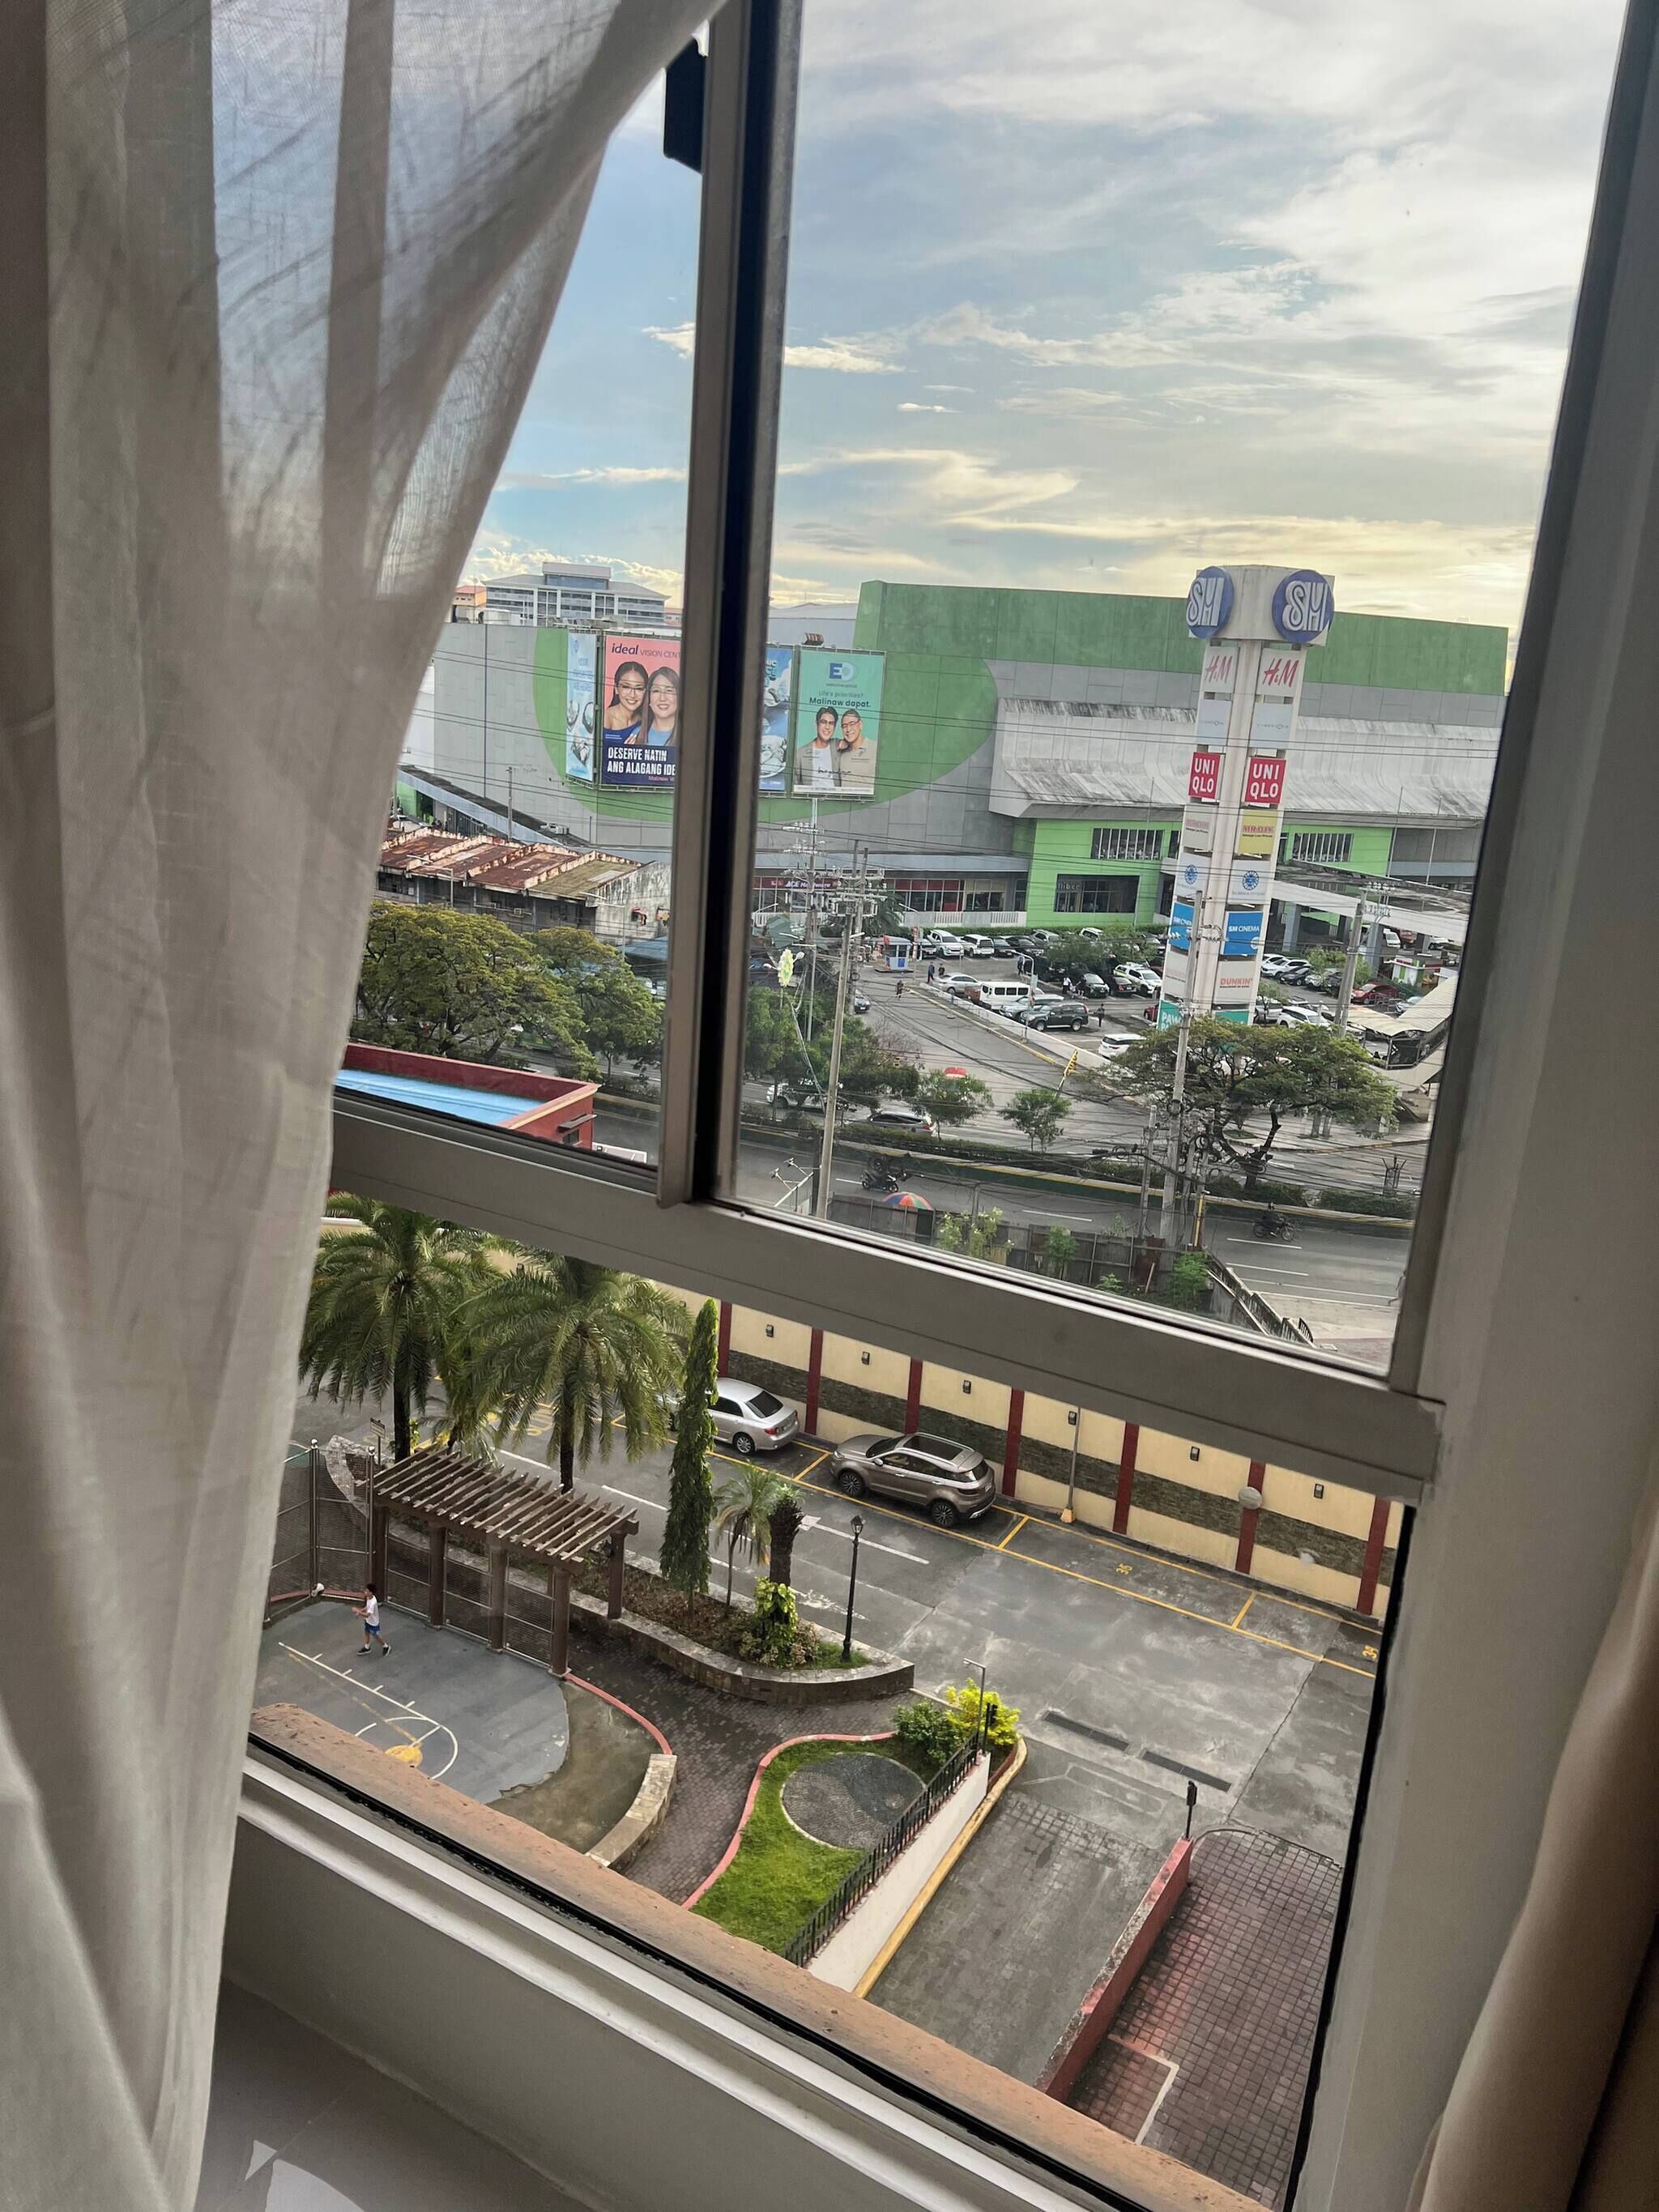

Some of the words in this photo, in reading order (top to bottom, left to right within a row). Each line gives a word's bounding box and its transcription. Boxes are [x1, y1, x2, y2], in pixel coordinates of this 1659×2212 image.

[1186, 577, 1225, 627] SM
[1282, 579, 1327, 632] SM
[612, 643, 638, 655] ideal
[640, 649, 663, 658] VISION
[1262, 658, 1299, 688] H&M
[809, 697, 843, 706] Malinaw
[608, 747, 642, 761] DESERVE
[644, 749, 667, 761] NATIN
[607, 761, 624, 774] ANG
[625, 762, 662, 775] ALAGANG
[1194, 757, 1215, 775] UNI
[1252, 763, 1280, 780] UNI
[1192, 776, 1214, 794] QLO
[1250, 782, 1279, 799] QLO
